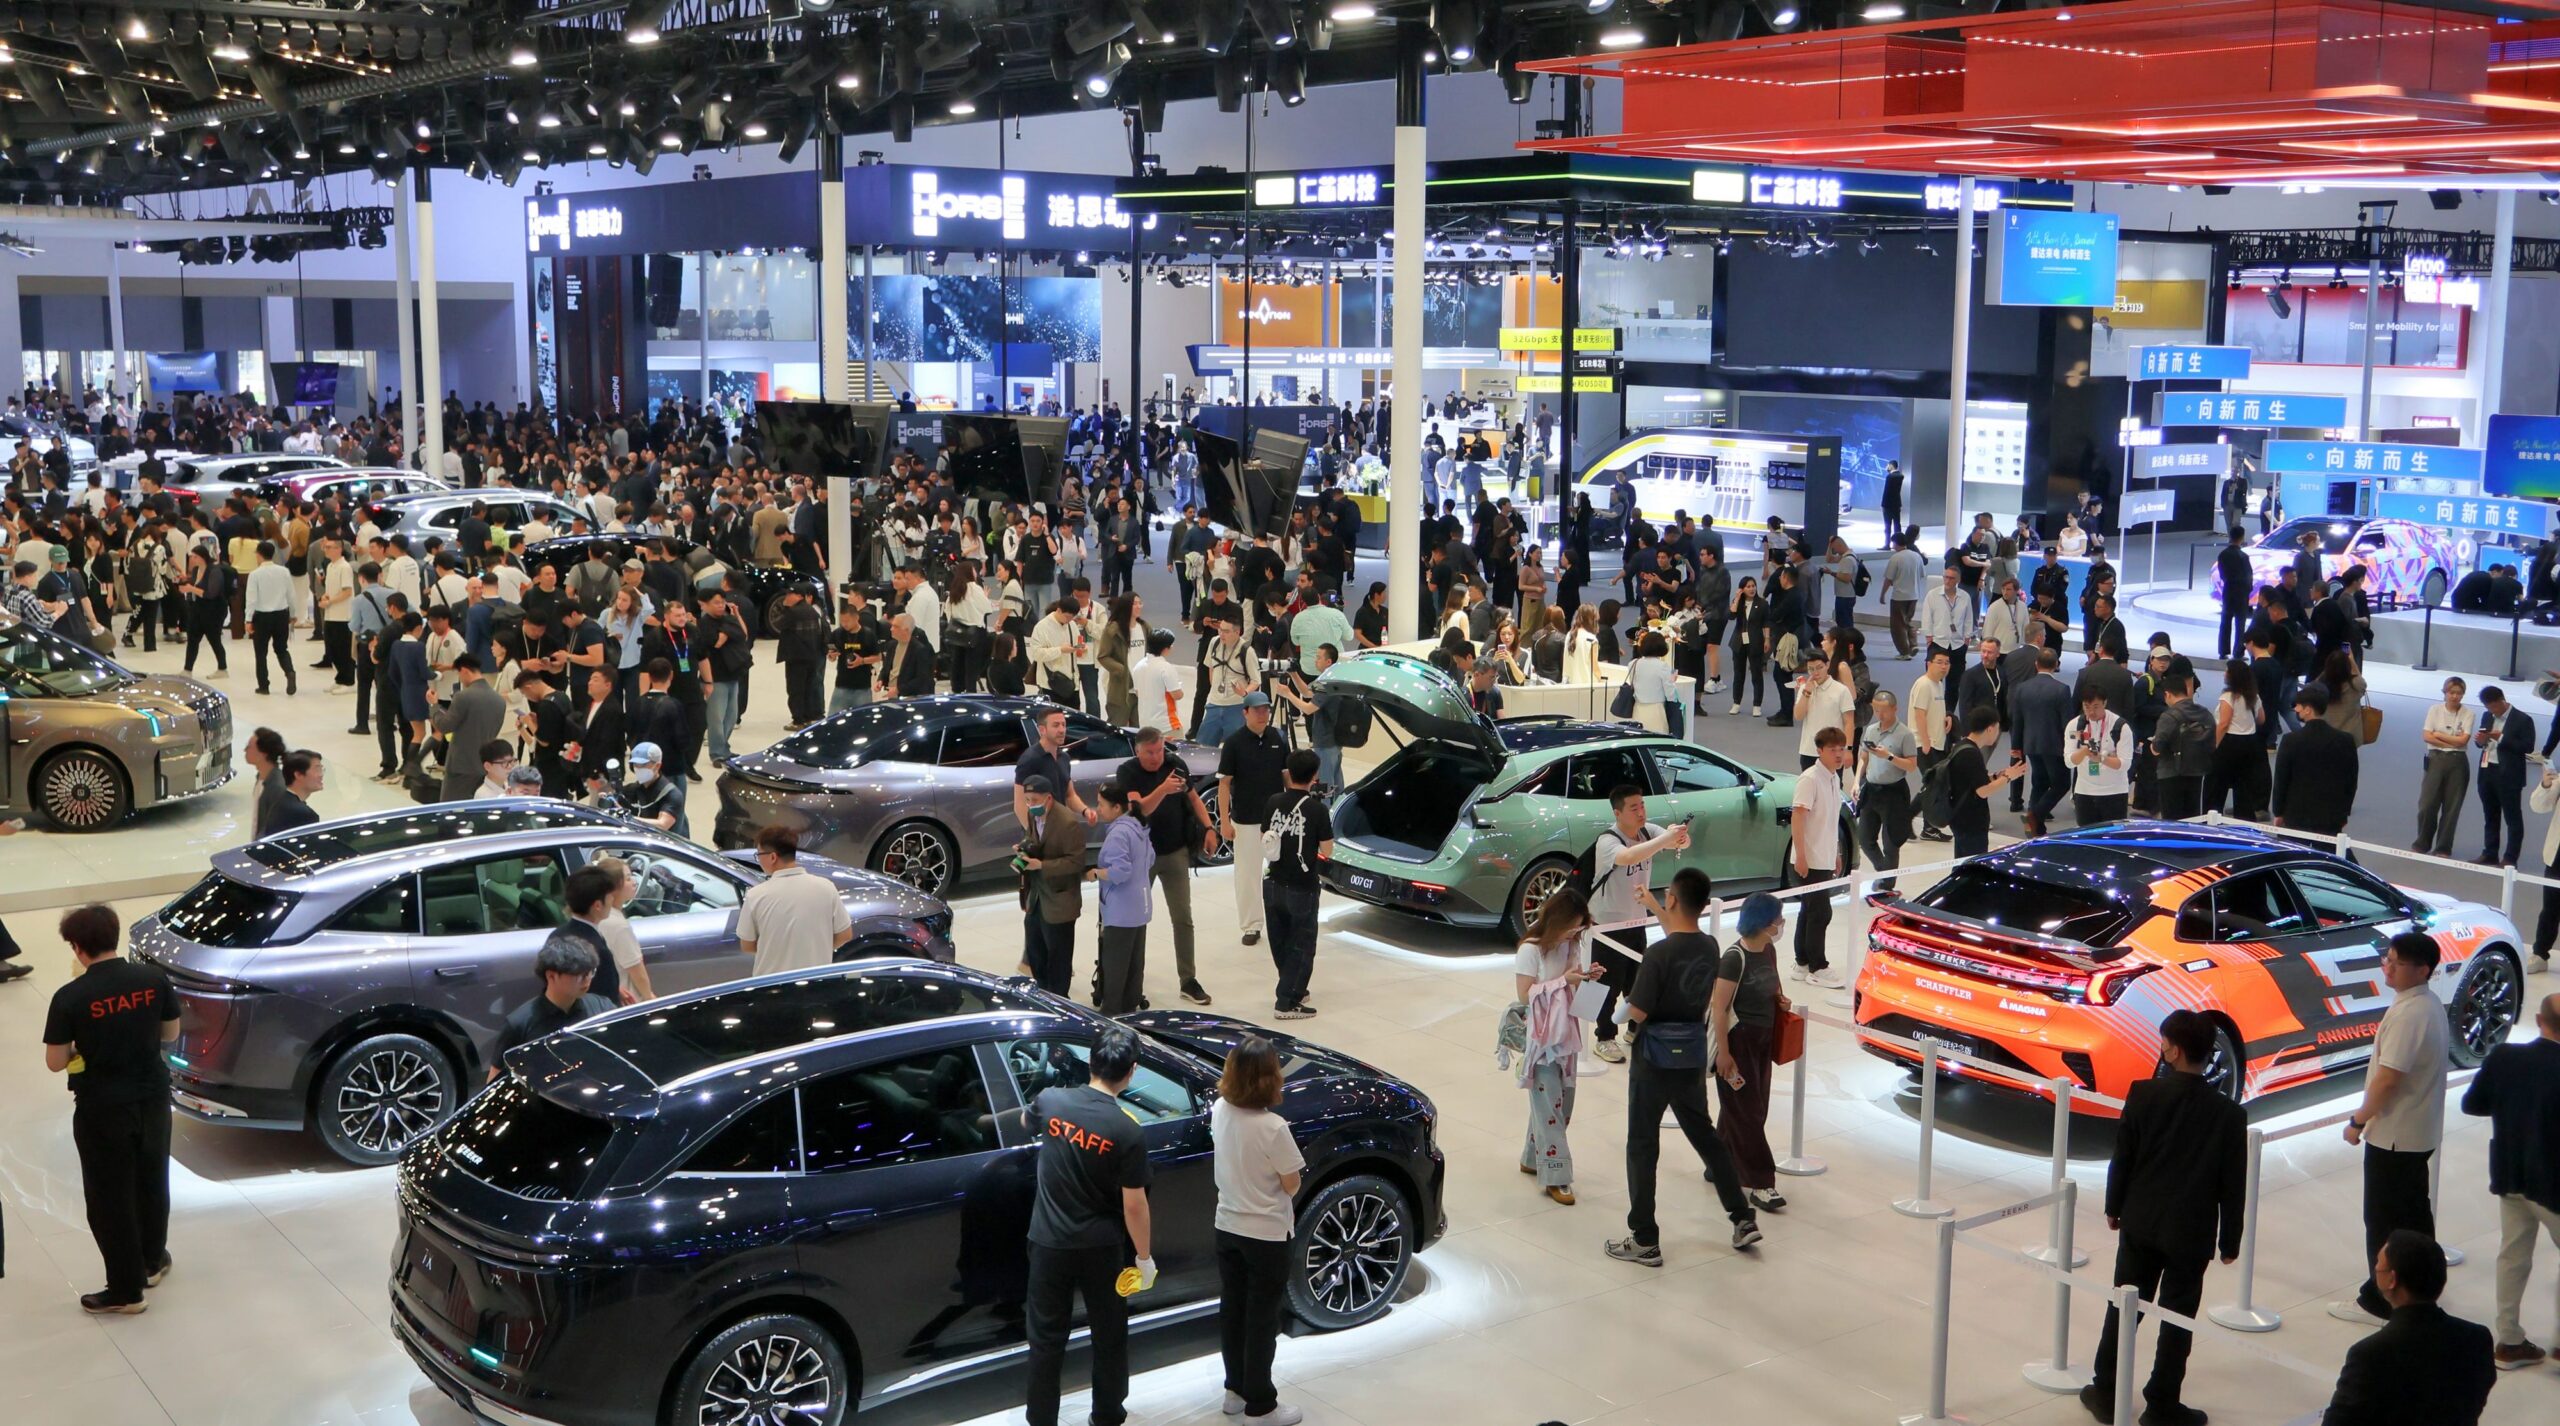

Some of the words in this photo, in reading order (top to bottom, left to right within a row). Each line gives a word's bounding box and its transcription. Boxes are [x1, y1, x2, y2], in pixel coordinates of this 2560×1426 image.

[2404, 254, 2446, 274] Lenovo
[2349, 322, 2385, 331] Smaer
[2387, 322, 2423, 333] Mobility
[2426, 322, 2440, 331] for
[2441, 322, 2455, 332] All
[2147, 351, 2202, 374] 向新而生
[2198, 398, 2287, 422] 向新而生
[2177, 453, 2209, 467] 向新而生
[2325, 446, 2430, 473] 向新而生
[2436, 499, 2519, 529] 向新而生
[1350, 874, 1364, 887] 007
[1363, 878, 1374, 889] GT
[1933, 952, 1966, 966] ZEEKR
[1915, 977, 1973, 1001] SCHAEFFLER
[90, 989, 157, 1019] STAFF
[2008, 1002, 2047, 1017] MAGNA
[1048, 1117, 1115, 1155] STAFF
[2001, 1203, 2030, 1217] ZEEKR
